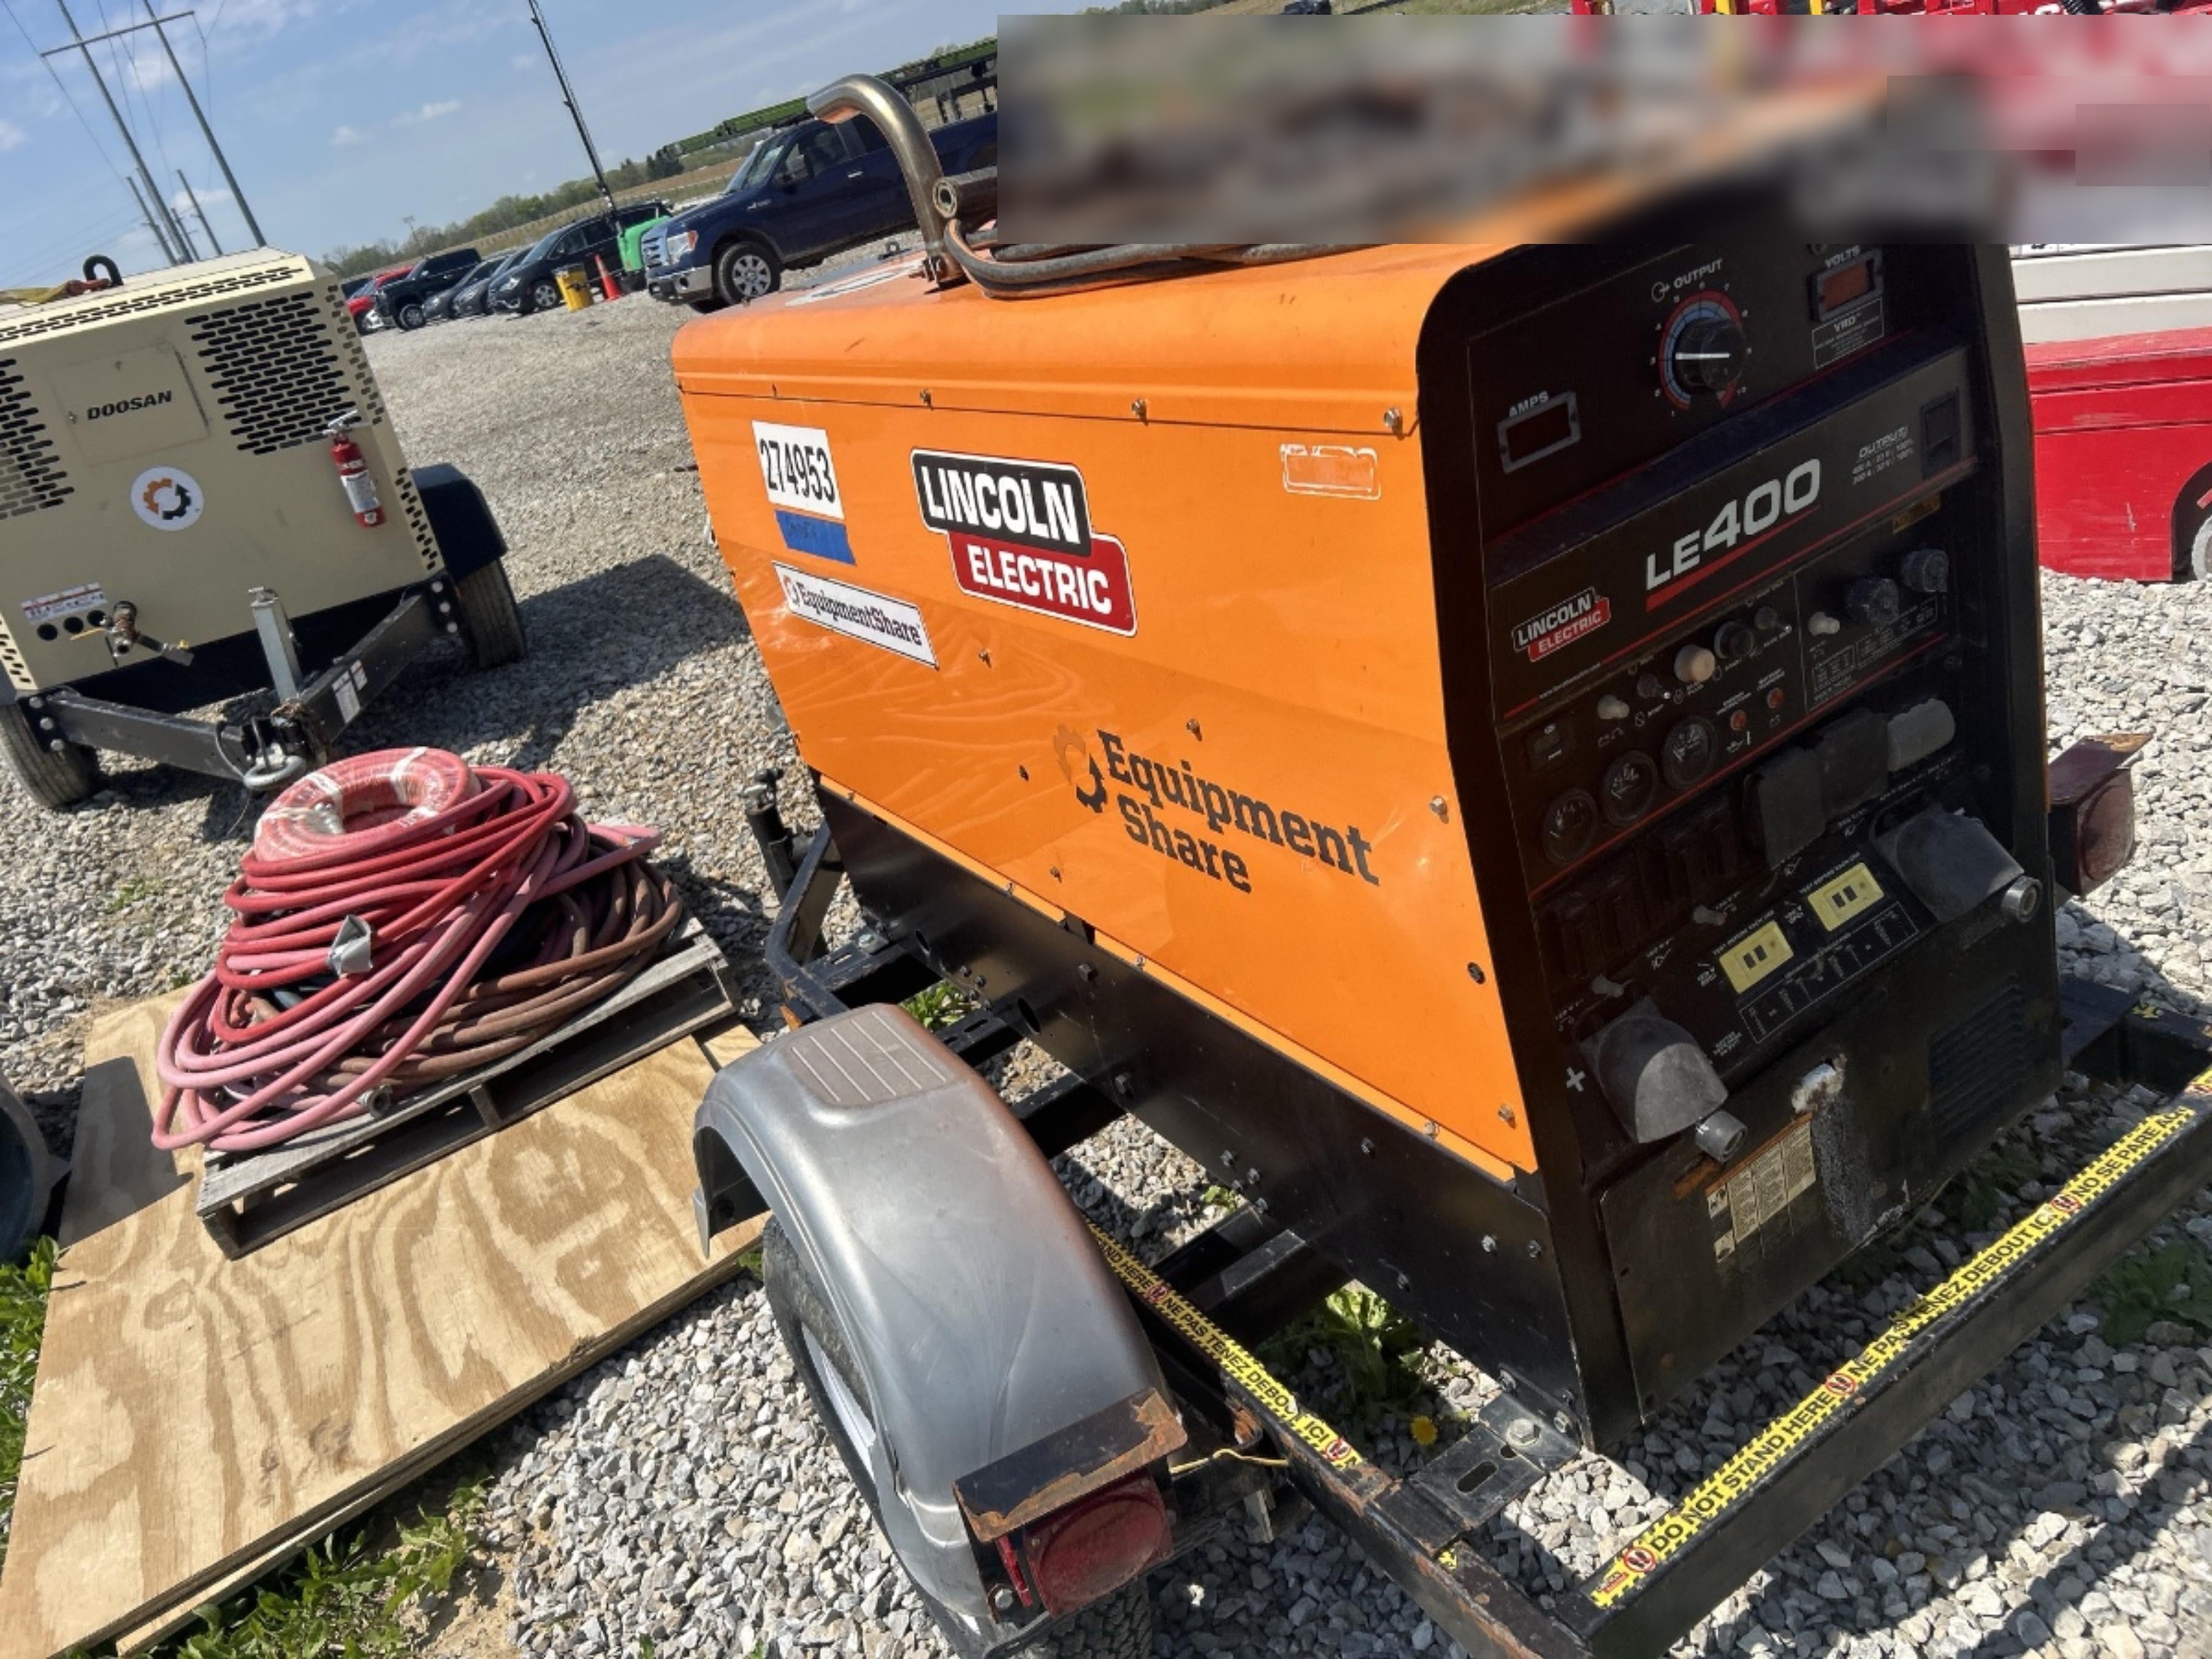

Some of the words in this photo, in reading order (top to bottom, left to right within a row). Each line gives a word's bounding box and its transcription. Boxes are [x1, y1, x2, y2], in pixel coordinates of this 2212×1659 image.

[1673, 257, 1724, 289] OUTPUT
[87, 389, 172, 421] DOOSAN
[1509, 390, 1550, 418] AMPS
[759, 437, 836, 504] 274953
[920, 465, 1081, 545] LINCOLN
[1645, 458, 1821, 591] LE400
[796, 581, 922, 646] EquipmentShare
[967, 543, 1113, 616] ELECTRIC
[1517, 593, 1593, 647] LINCOLN
[1537, 609, 1602, 654] ELECTRIC
[1097, 729, 1380, 887] Equipment
[1117, 793, 1253, 895] Share
[2074, 1177, 2100, 1199] NO
[2095, 1159, 2121, 1177] SE
[2116, 1126, 2160, 1159] PARE
[1120, 1260, 1155, 1289] HERE
[1849, 1352, 1880, 1378] NE
[1961, 1229, 2034, 1284] DEBOUT
[2034, 1210, 2060, 1231] IC
[1164, 1296, 1184, 1316] NE
[1180, 1312, 1209, 1337] PAS
[1206, 1333, 1252, 1374] TENEZ
[1303, 1421, 1331, 1443] ICI
[1650, 1523, 1684, 1552] DO
[1681, 1485, 1725, 1526] NOT
[1721, 1434, 1786, 1490] STAND
[1781, 1390, 1835, 1436] HERE
